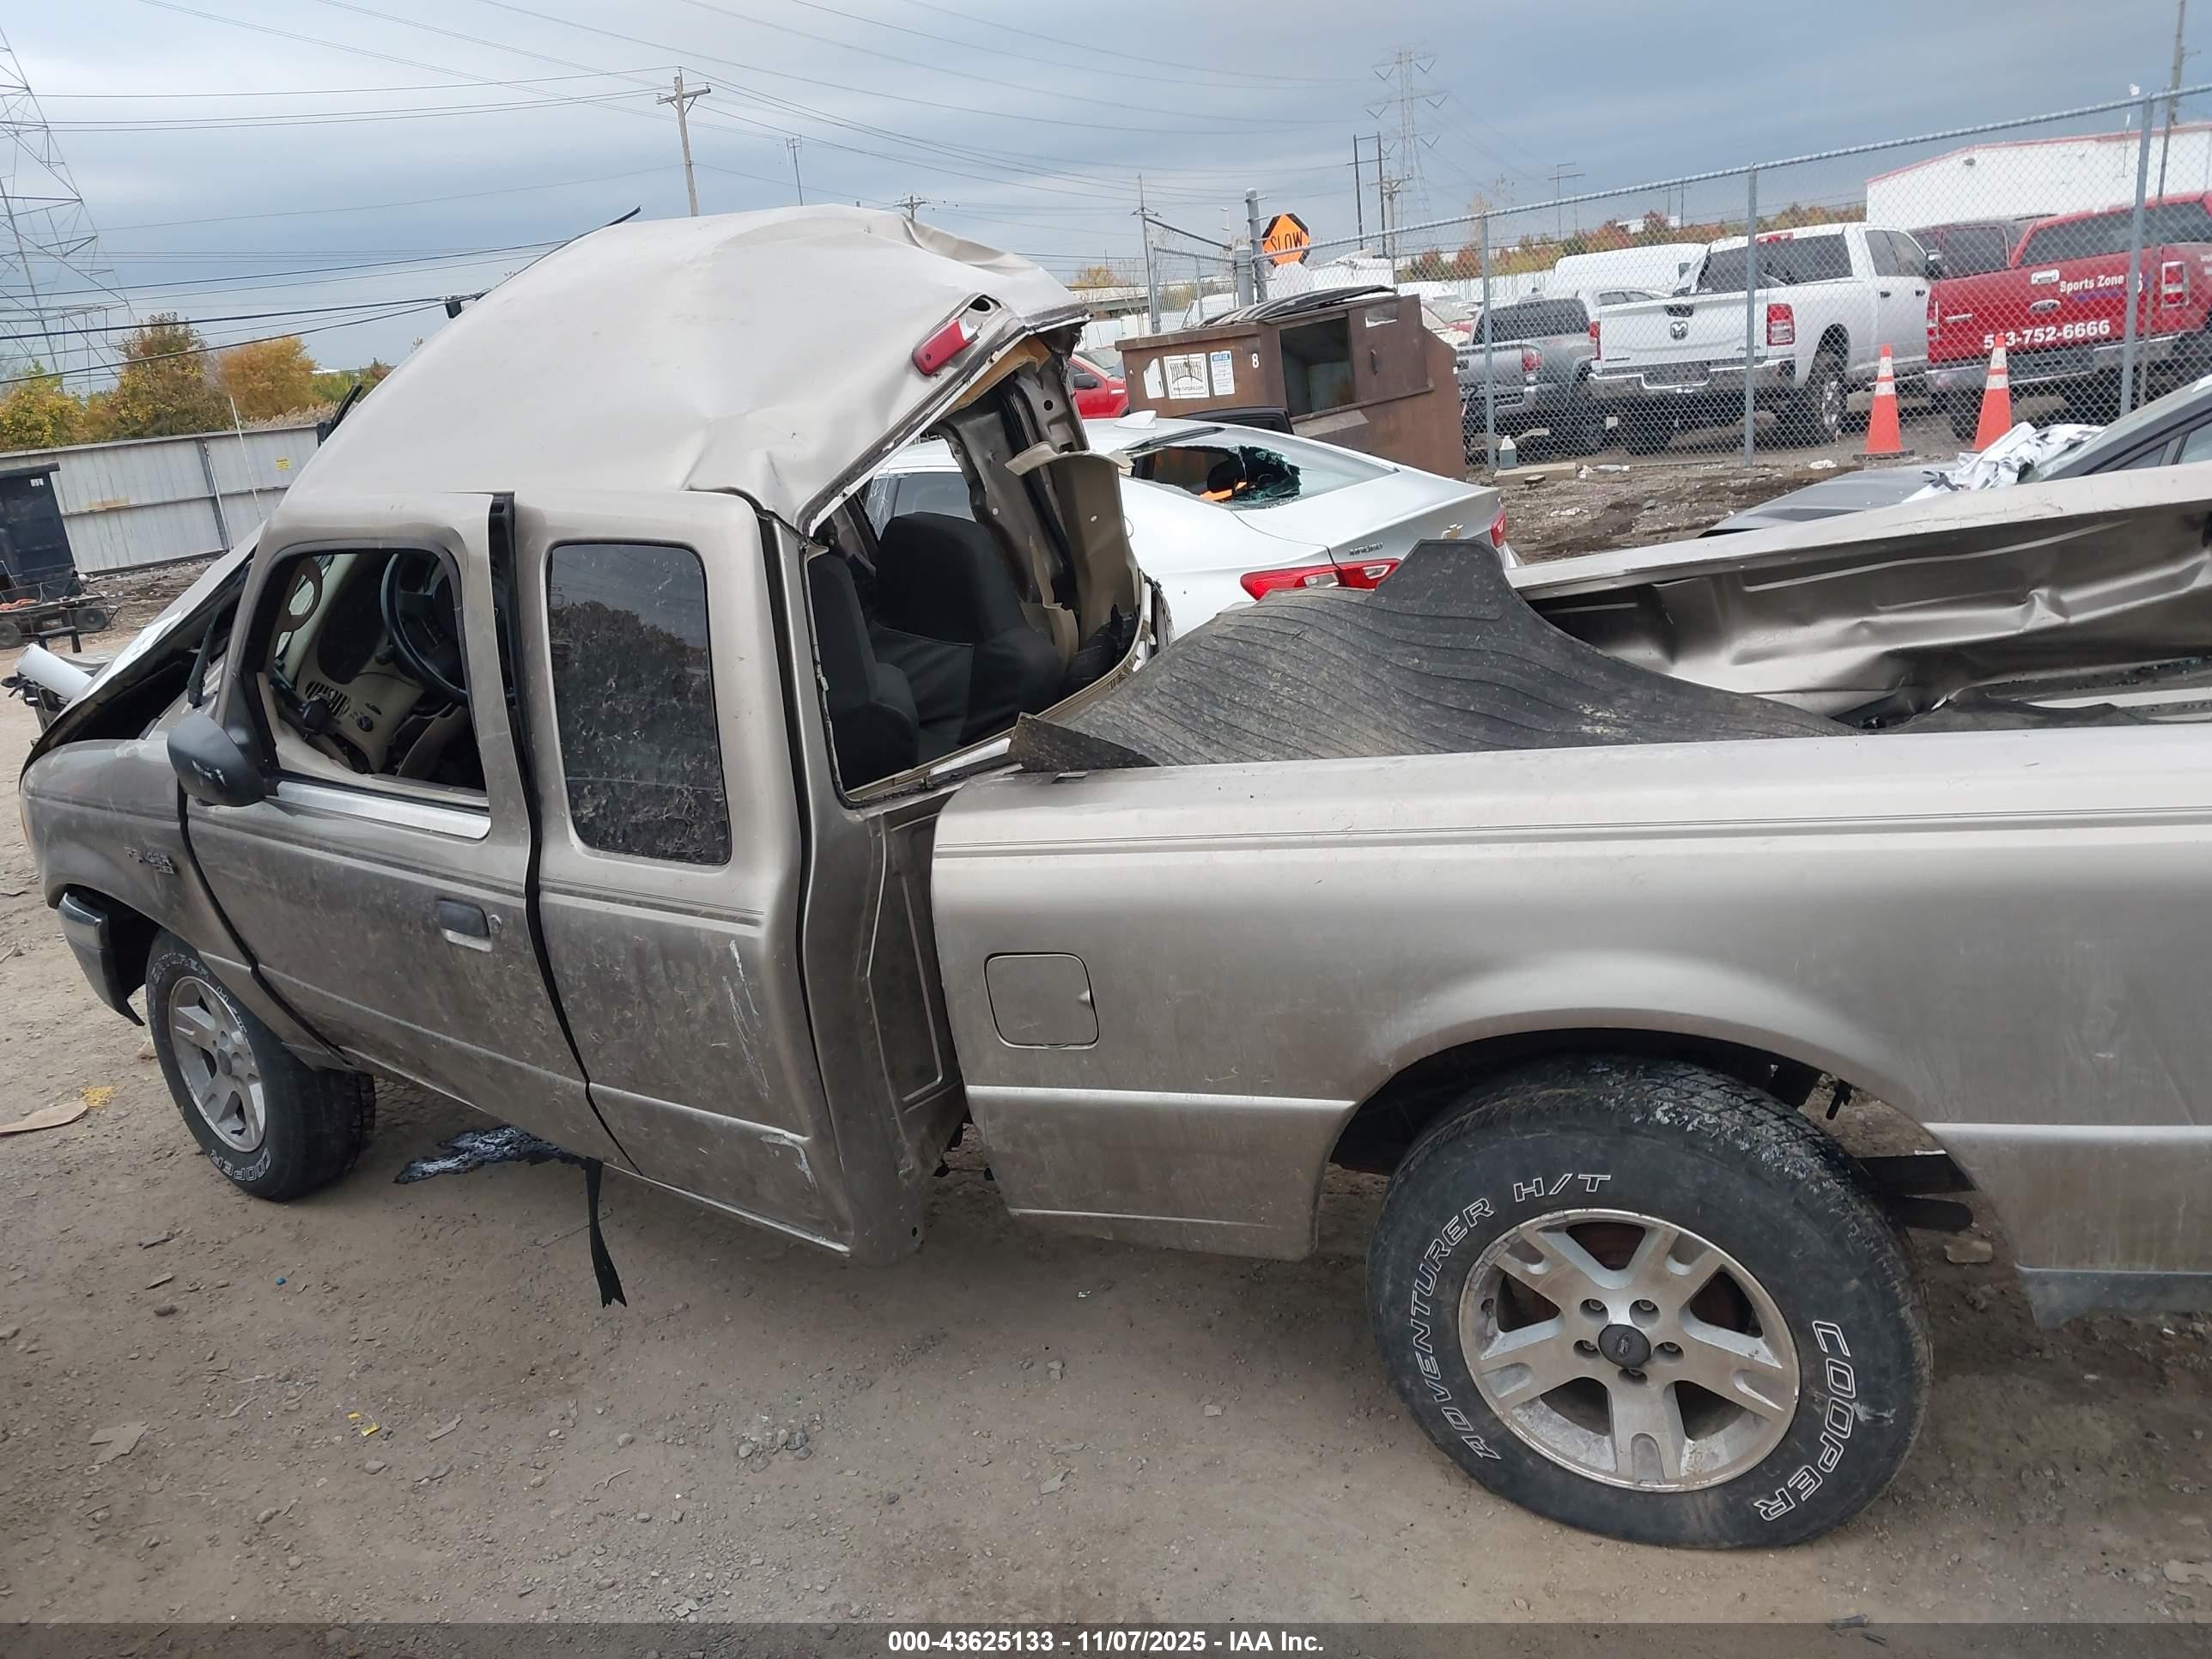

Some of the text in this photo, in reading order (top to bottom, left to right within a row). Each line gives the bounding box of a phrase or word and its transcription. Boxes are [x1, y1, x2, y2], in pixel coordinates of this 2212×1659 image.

[1270, 230, 1303, 252] SLOW
[2060, 278, 2095, 295] Sports
[2097, 273, 2124, 288] Zone
[1984, 319, 2111, 349] 53-752-6666
[1251, 353, 1260, 369] 8
[210, 1146, 271, 1182] COOPER
[1410, 1173, 1612, 1460] ADVENTURER H/T
[1753, 1320, 1856, 1522] COOPER
